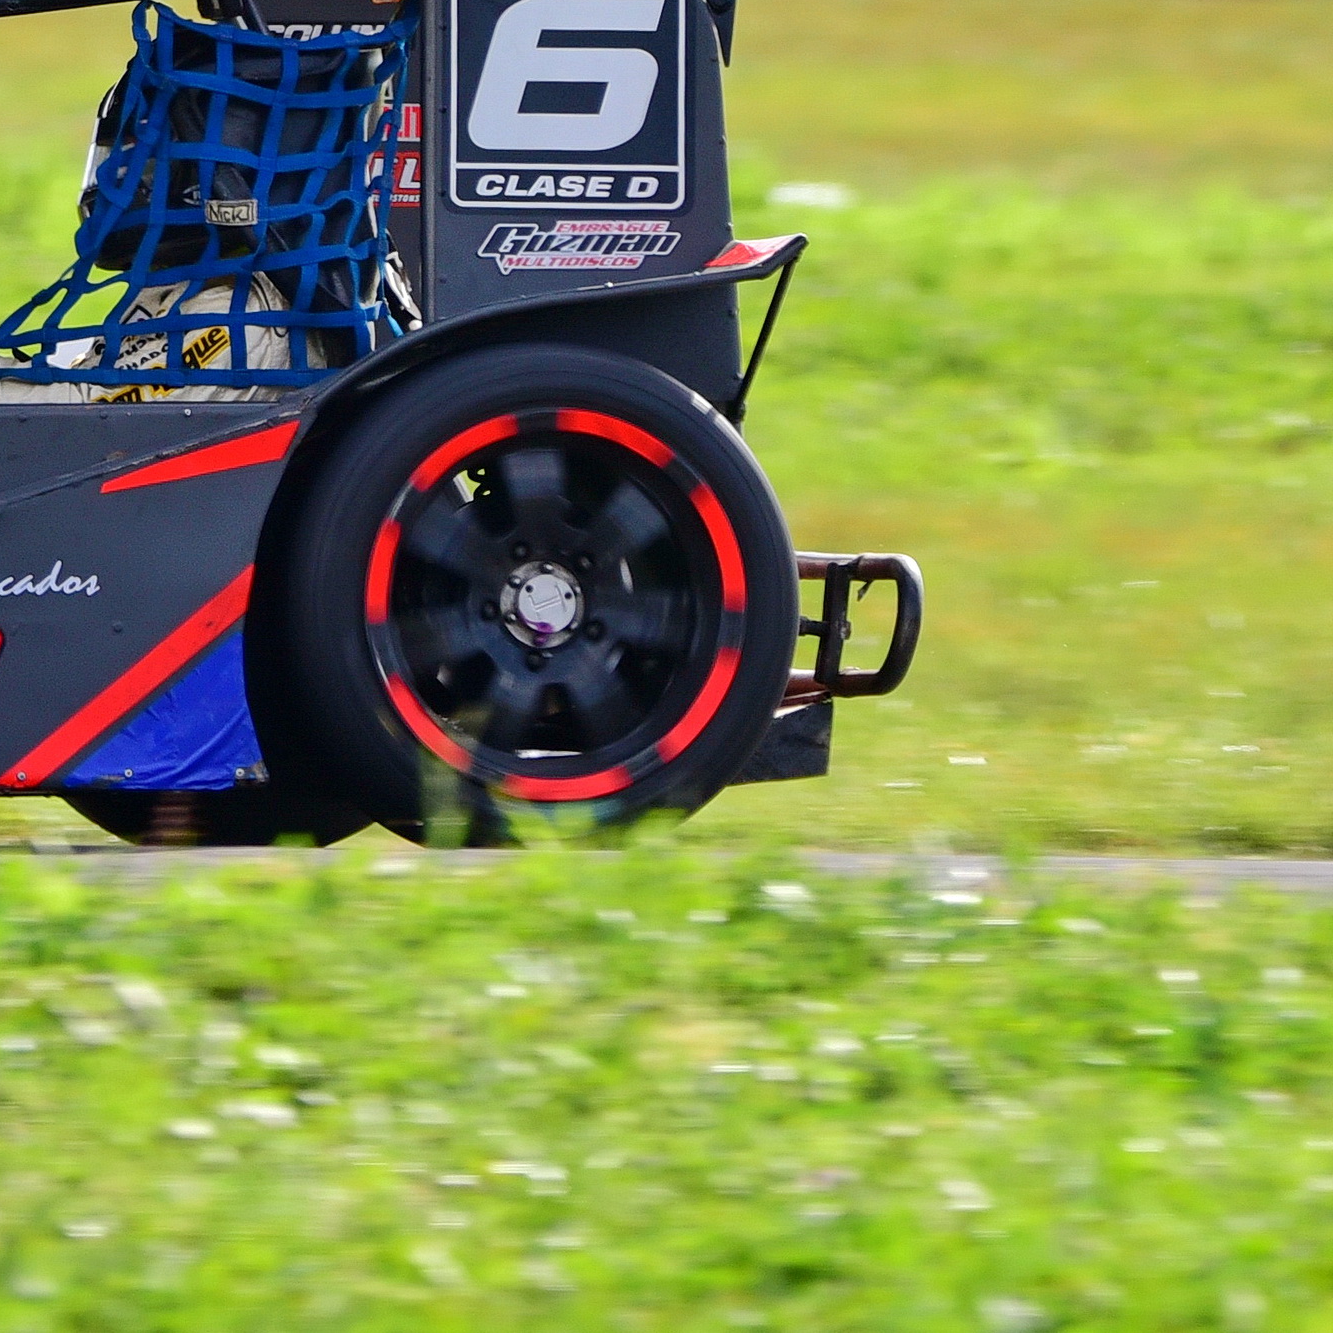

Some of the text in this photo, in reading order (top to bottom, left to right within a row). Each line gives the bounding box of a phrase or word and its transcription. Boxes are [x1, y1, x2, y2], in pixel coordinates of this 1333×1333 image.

[475, 174, 660, 199] CLASE D
[555, 221, 668, 233] EMBRAGUE
[480, 224, 680, 256] Guzman
[503, 256, 643, 267] MULTIDISCOS
